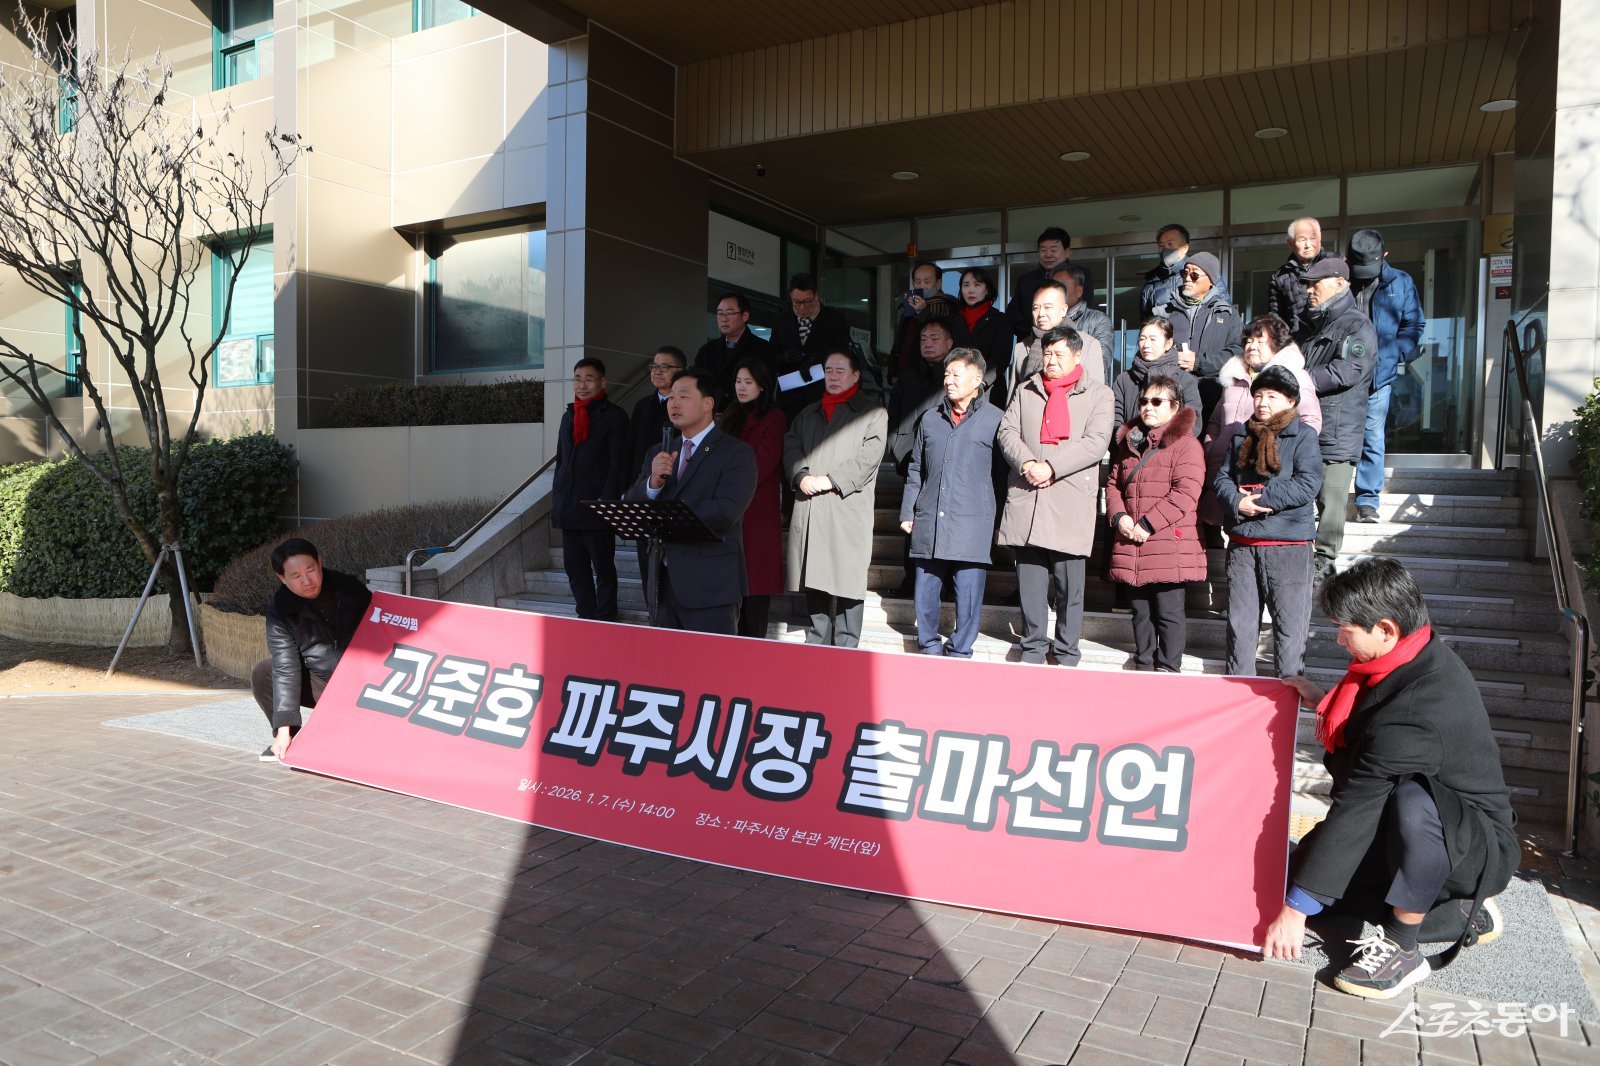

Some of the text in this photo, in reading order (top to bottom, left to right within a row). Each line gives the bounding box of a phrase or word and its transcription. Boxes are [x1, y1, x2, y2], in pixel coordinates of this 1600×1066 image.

[381, 612, 419, 632] 국민의힘
[357, 645, 1193, 850] 고준호 파주시장 출마선언
[517, 778, 543, 795] 일시
[547, 785, 582, 802] 2026.
[586, 792, 595, 805] 1.
[598, 794, 609, 808] 7.
[611, 797, 636, 813] (수)
[638, 802, 676, 819] 14:00
[695, 812, 722, 829] 장소
[732, 819, 790, 841] 파주시청
[791, 829, 822, 847] 본관
[823, 835, 882, 857] 계단(앞)
